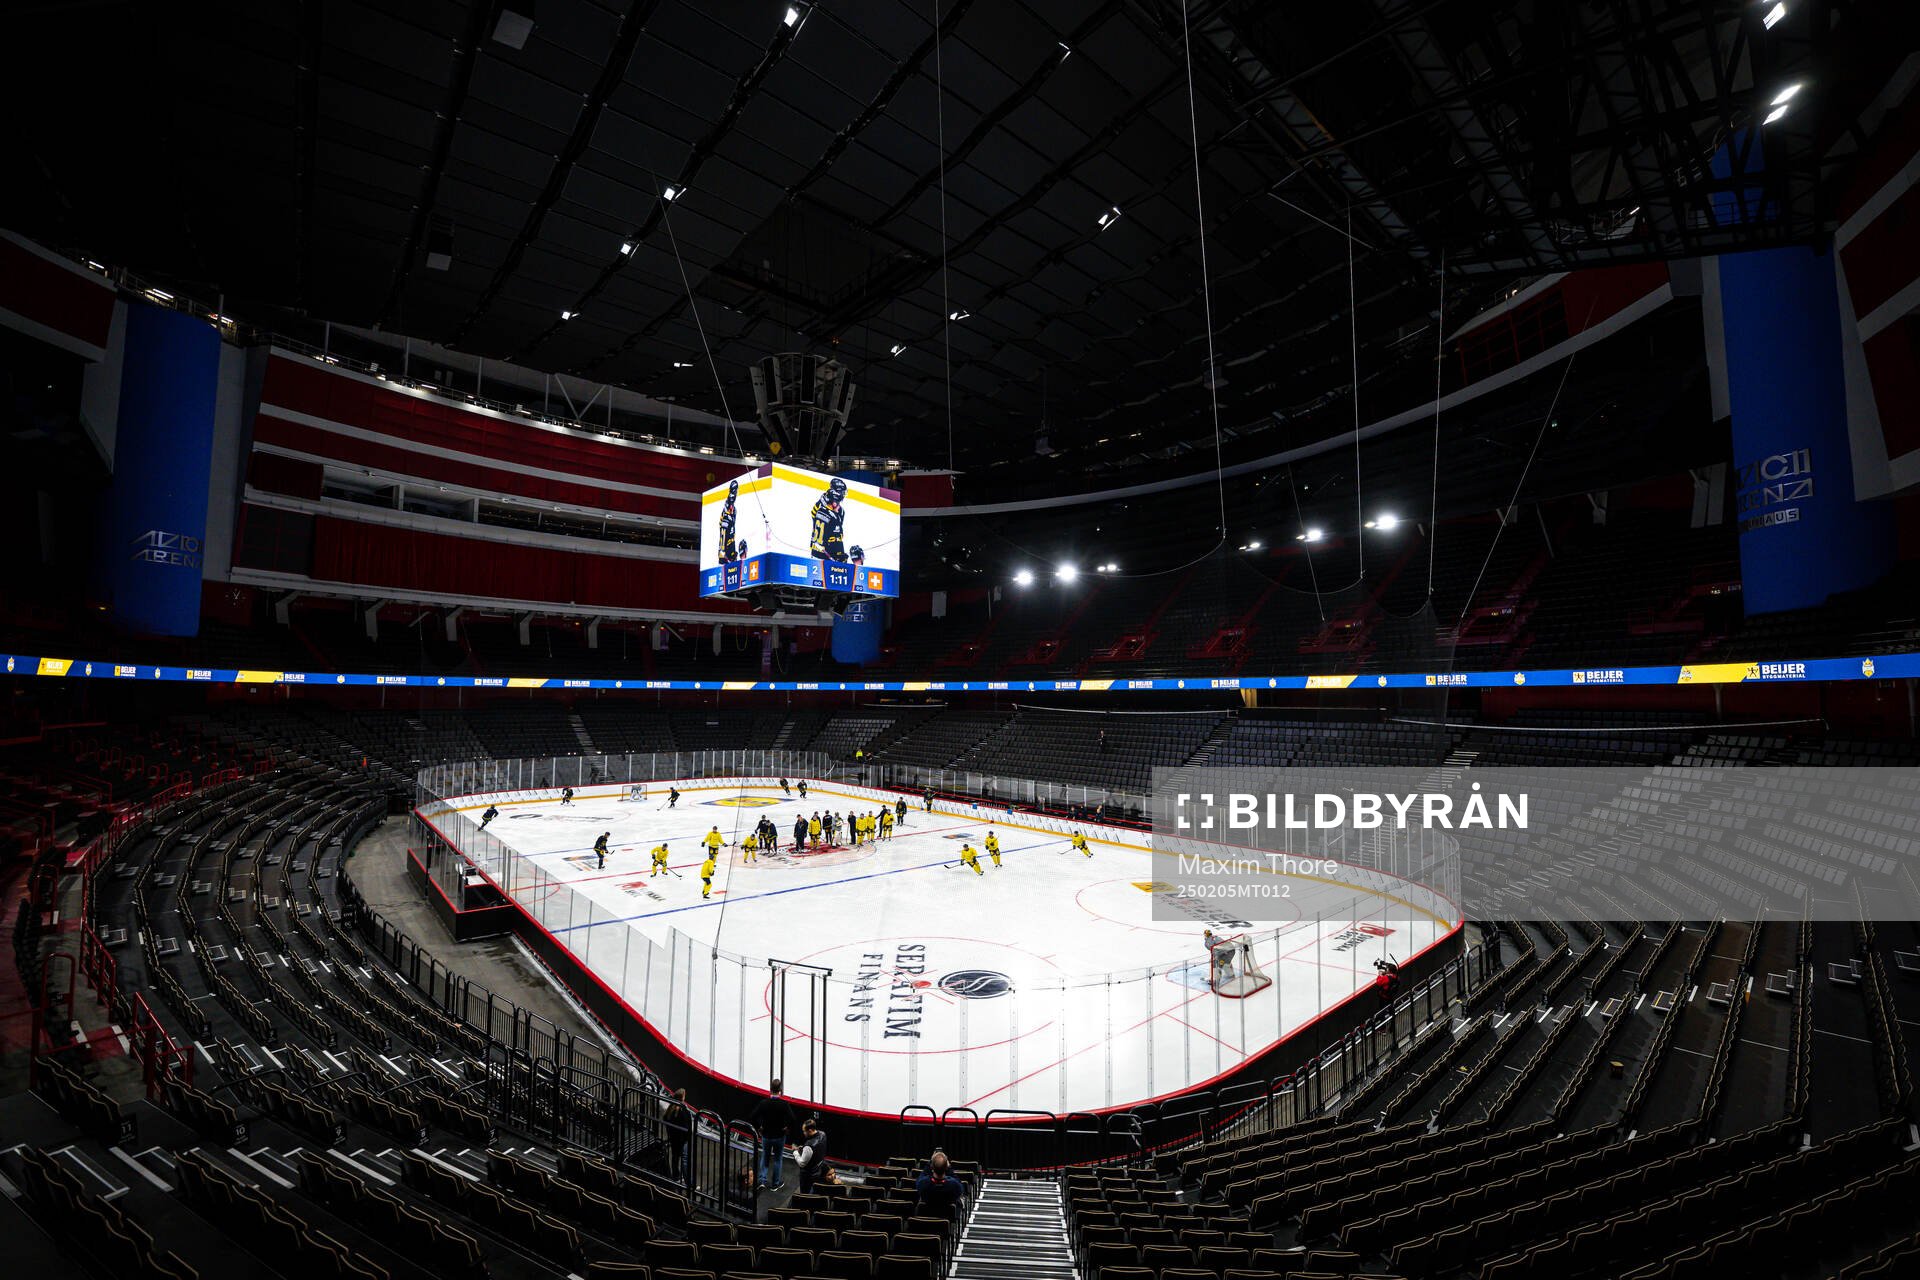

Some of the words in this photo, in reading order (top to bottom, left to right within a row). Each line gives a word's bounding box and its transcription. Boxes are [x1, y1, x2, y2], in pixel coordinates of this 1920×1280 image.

[812, 566, 818, 575] 2
[829, 574, 848, 585] 1:11
[1761, 663, 1805, 674] BEIJER
[1586, 670, 1624, 679] BEIJER
[844, 953, 884, 1023] FINANS
[883, 944, 926, 1039] SERAFIM
